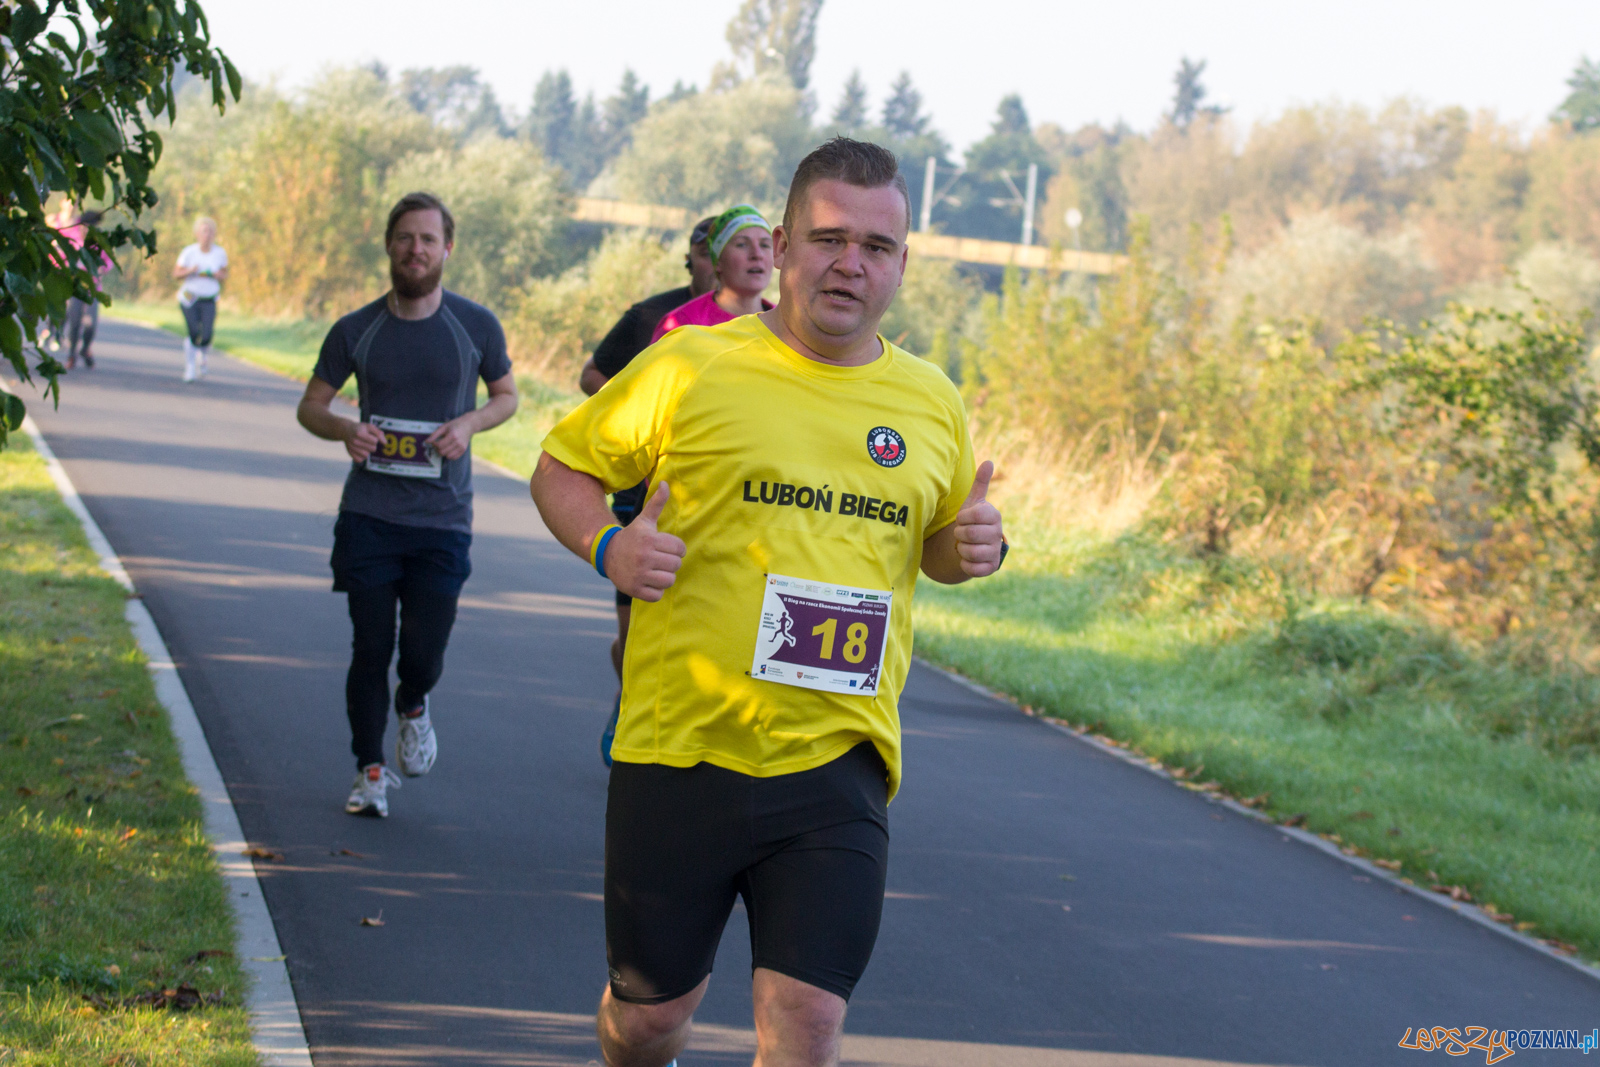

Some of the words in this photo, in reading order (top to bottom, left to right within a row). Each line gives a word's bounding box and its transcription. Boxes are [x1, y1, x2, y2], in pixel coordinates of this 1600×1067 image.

[382, 433, 417, 459] 96
[868, 441, 878, 459] KLUB
[881, 449, 905, 466] BIEGACZA
[743, 480, 833, 513] LUBOŃ
[838, 492, 909, 527] BIEGA
[788, 597, 799, 605] Bieg
[811, 618, 869, 664] 18
